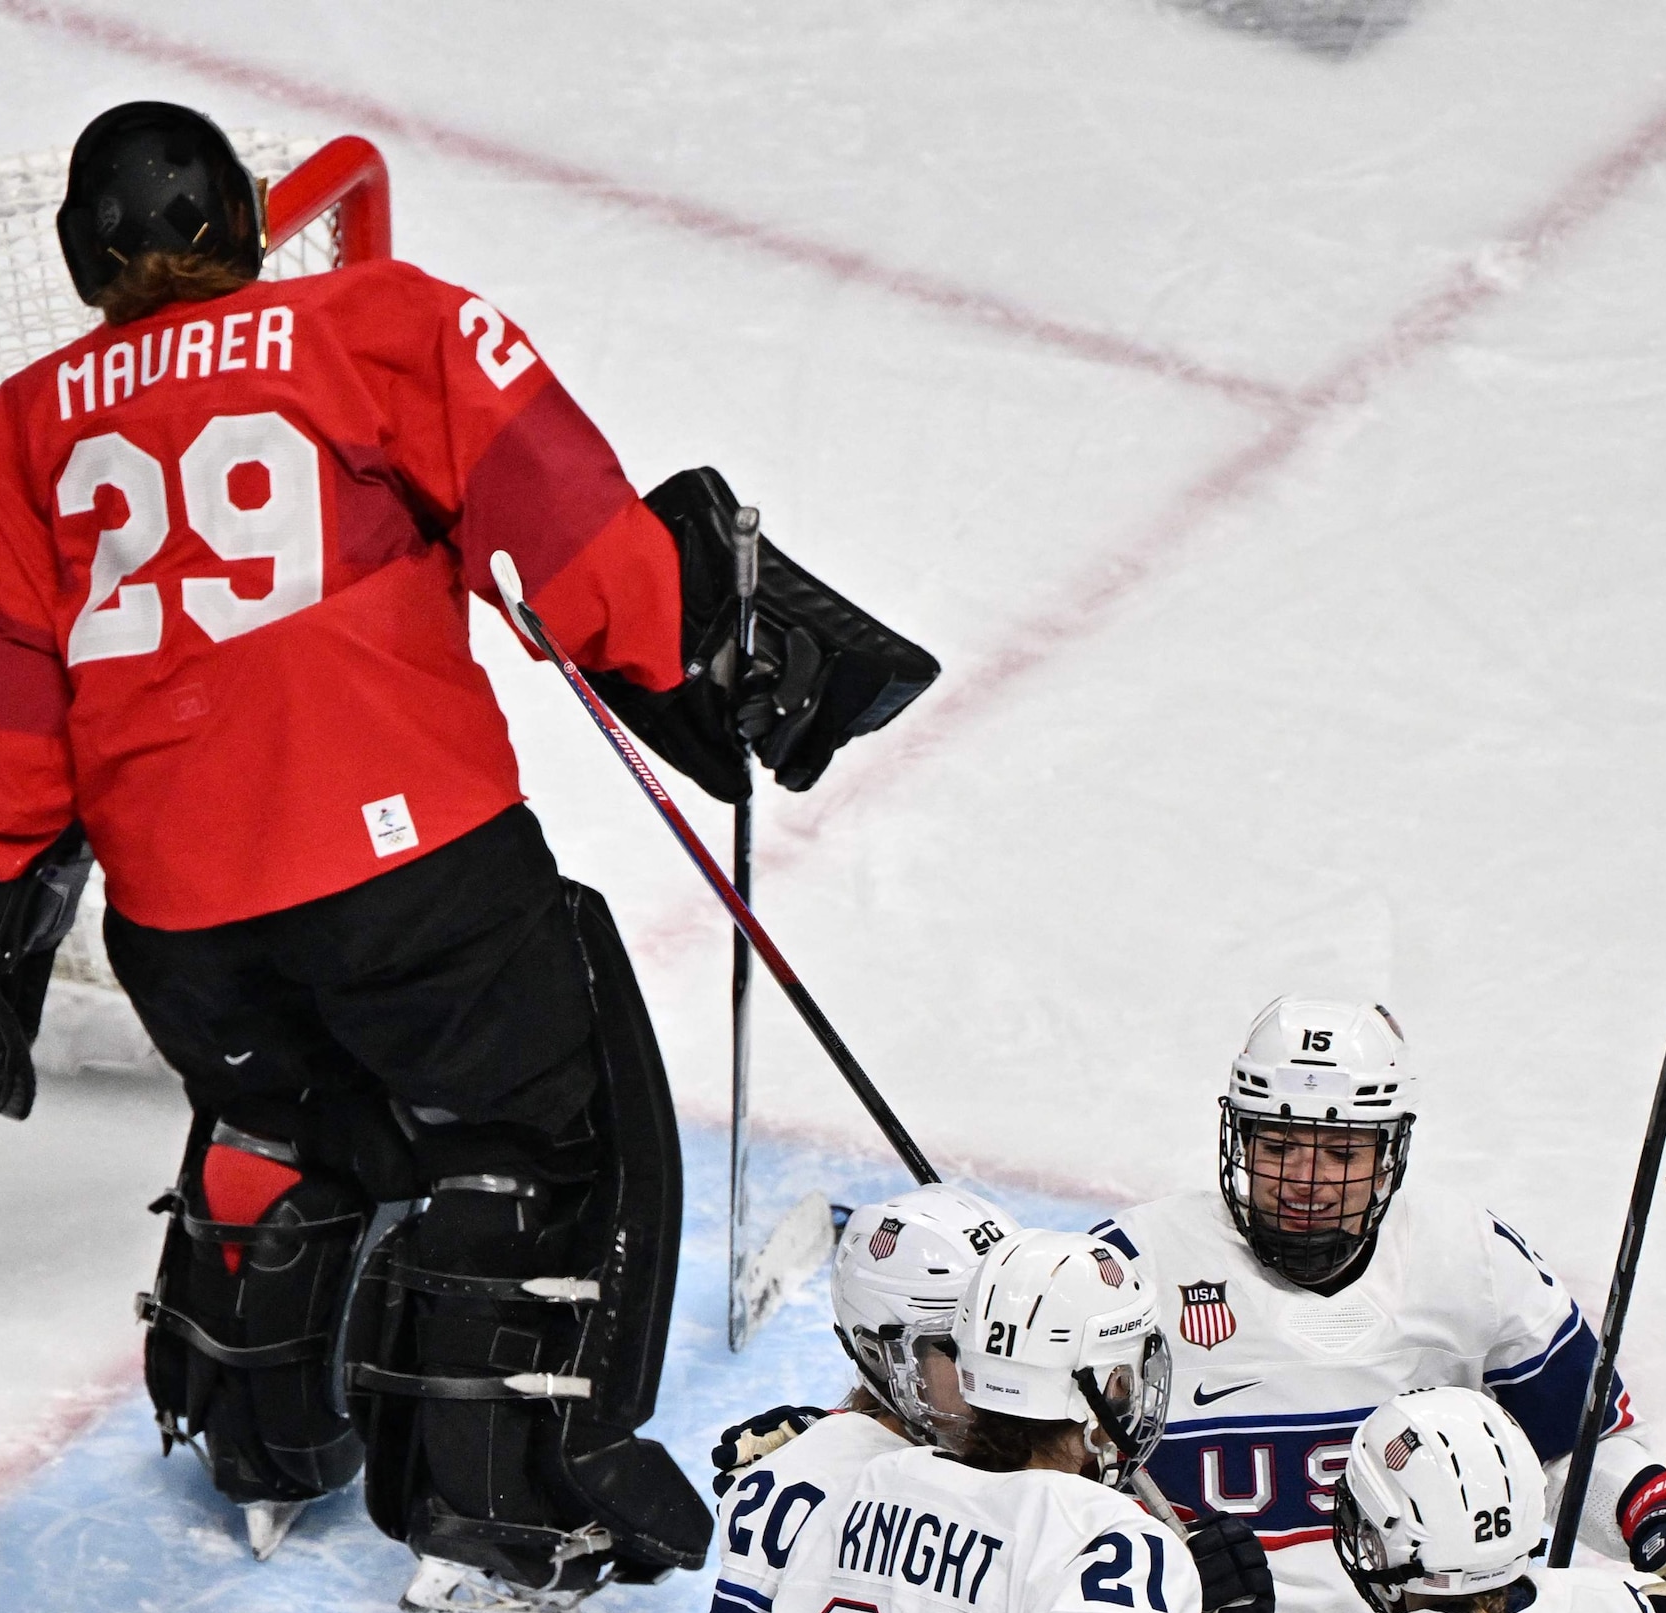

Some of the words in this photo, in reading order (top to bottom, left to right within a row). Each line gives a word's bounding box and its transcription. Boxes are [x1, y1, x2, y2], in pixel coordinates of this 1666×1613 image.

[57, 306, 294, 420] MAURER
[56, 411, 323, 668] 29
[1301, 1029, 1333, 1052] 15
[883, 1220, 900, 1233] USA
[1187, 1287, 1221, 1302] USA
[986, 1320, 1017, 1358] 21
[1402, 1431, 1417, 1449] USA
[728, 1470, 827, 1569] 20
[1473, 1506, 1512, 1544] 26
[838, 1500, 1005, 1605] KNIGHT
[1079, 1531, 1169, 1613] 21
